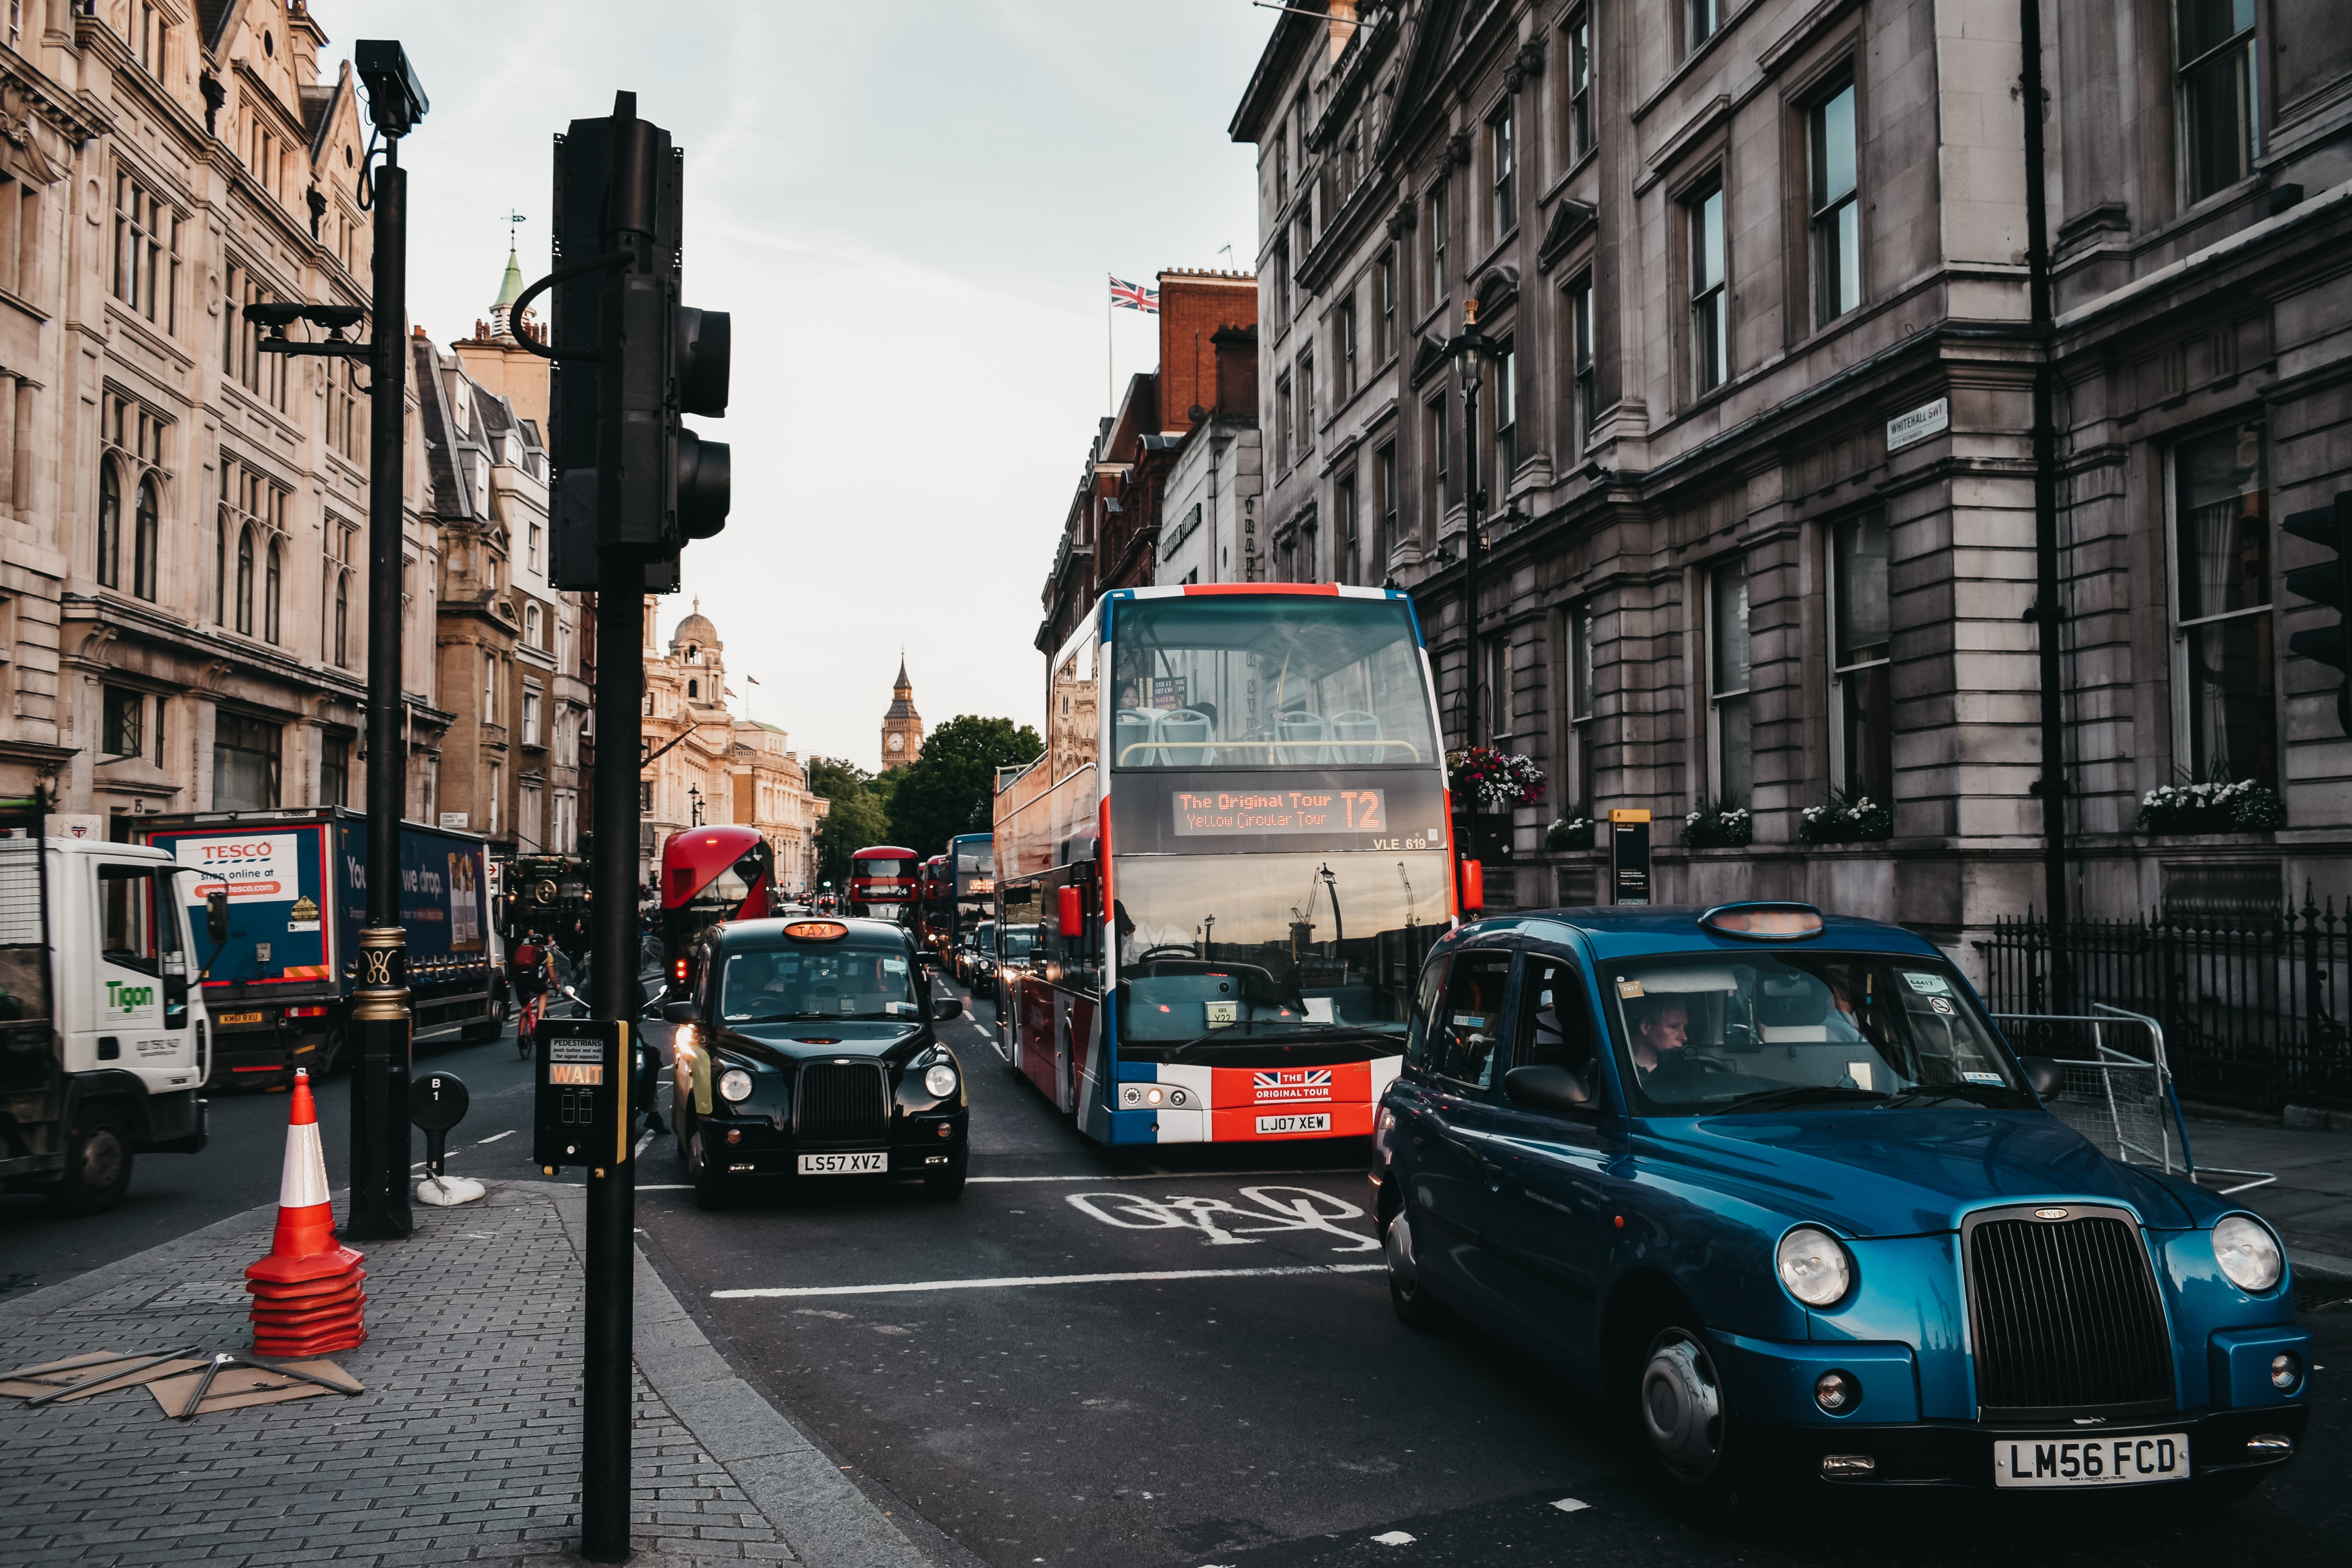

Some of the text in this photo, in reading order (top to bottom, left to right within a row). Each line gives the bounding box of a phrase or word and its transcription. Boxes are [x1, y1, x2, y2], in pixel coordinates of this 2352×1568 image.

[1891, 403, 1942, 434] WHITEHALL SW1
[1179, 792, 1332, 811] The Original Tour
[1340, 791, 1379, 828] T2
[1187, 811, 1327, 830] Yellow Circular Tour
[202, 843, 272, 859] TESCO
[1373, 838, 1426, 850] VLE 619
[229, 869, 260, 879] online
[264, 868, 274, 877] at
[202, 883, 274, 895] wwwtesco.com
[402, 869, 417, 892] we
[419, 863, 443, 901] drop.
[797, 926, 833, 936] TAXI
[105, 980, 155, 1013] Tigon
[432, 1078, 441, 1088] B
[552, 1066, 603, 1084] WAIT
[433, 1091, 438, 1100] 1
[1256, 1088, 1329, 1099] ORIGINAL TOUR
[1261, 1116, 1324, 1131] LJ07 XEW
[805, 1155, 881, 1171] LS57 XVZ
[2010, 1438, 2176, 1478] LM56 FCD
